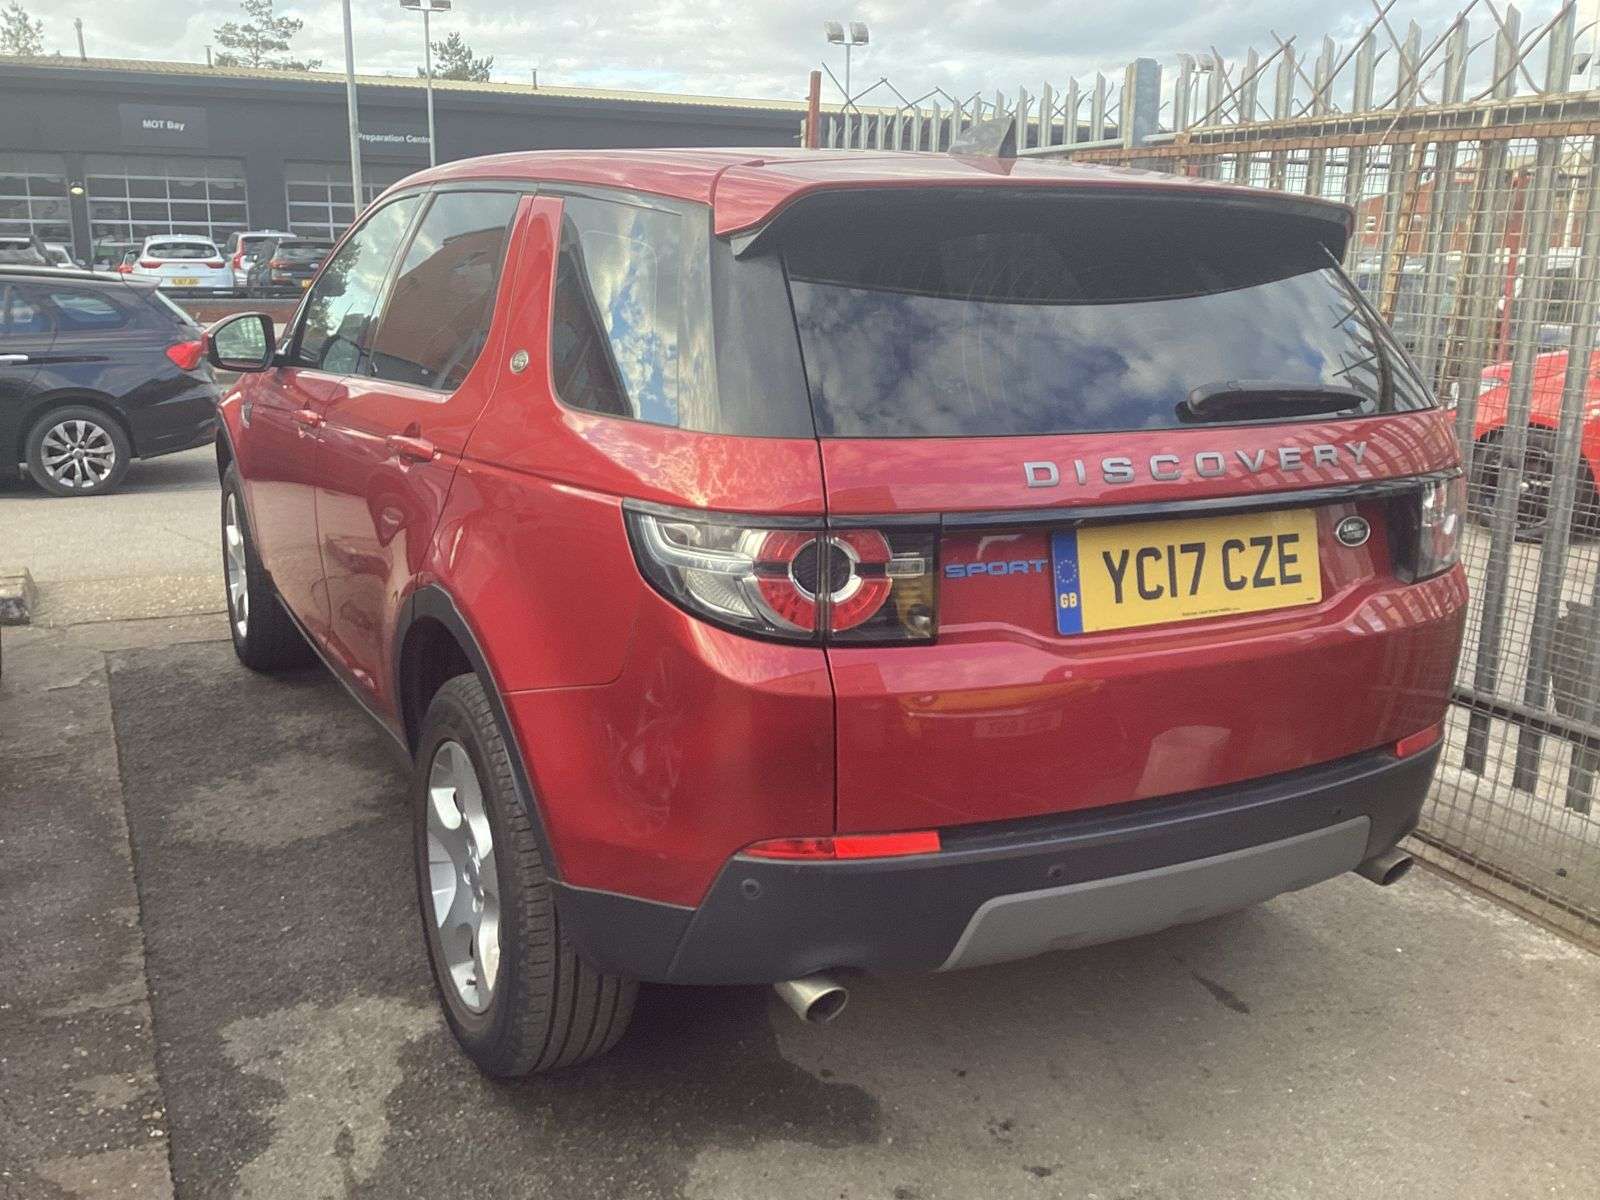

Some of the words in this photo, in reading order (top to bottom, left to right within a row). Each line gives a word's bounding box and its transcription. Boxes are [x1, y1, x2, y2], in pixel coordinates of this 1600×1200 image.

[142, 119, 165, 129] MOT
[166, 120, 185, 131] Bay
[405, 135, 430, 143] Centr
[1023, 440, 1368, 488] DISCOVERY
[944, 559, 1048, 578] SPORT
[1102, 542, 1206, 604] YC17
[1221, 533, 1302, 591] CZE
[1059, 592, 1078, 609] GB
